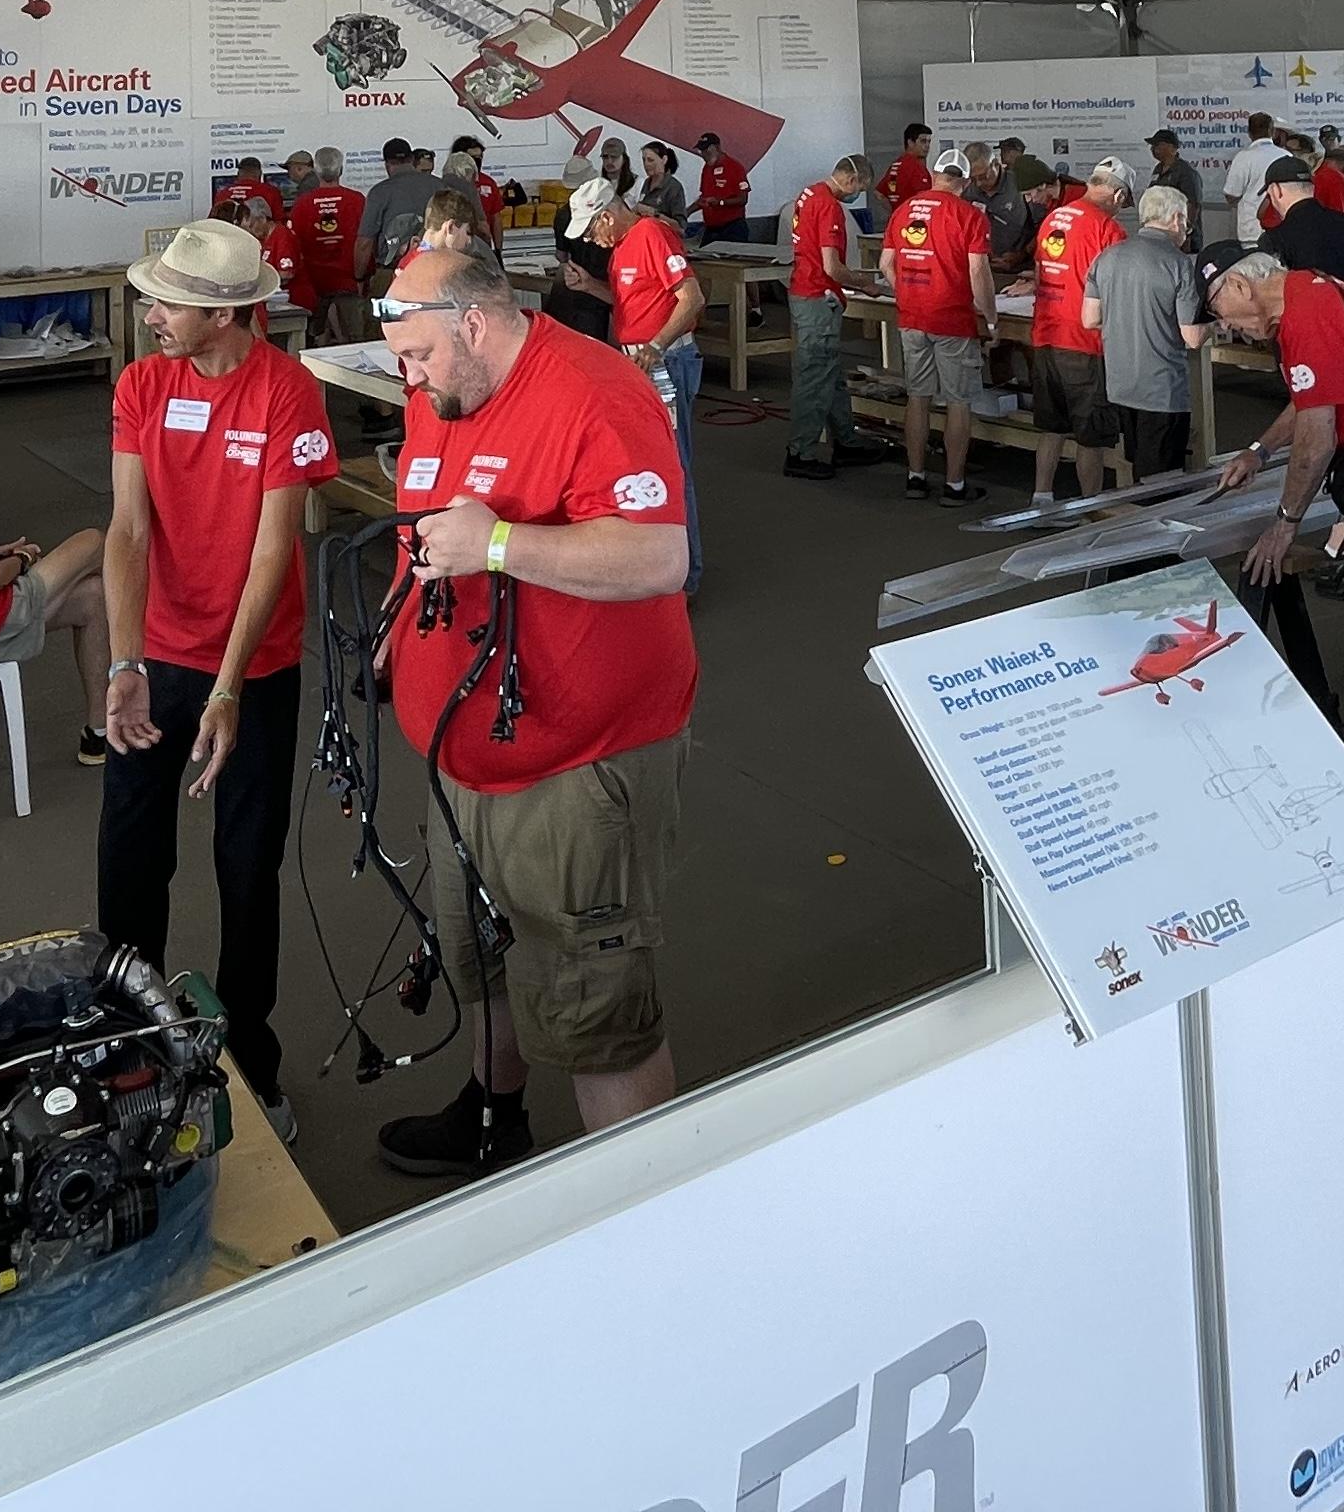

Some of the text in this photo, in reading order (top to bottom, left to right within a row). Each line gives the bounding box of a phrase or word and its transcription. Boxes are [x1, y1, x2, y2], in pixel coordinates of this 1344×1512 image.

[45, 68, 151, 93] Aircraft
[20, 94, 182, 116] in Seven Days
[344, 92, 405, 107] ROTAX
[938, 102, 962, 112] EAA
[996, 100, 1029, 110] Home
[1032, 99, 1048, 110] for
[1051, 98, 1135, 109] Homebuilders
[1166, 96, 1229, 106] More than
[1295, 93, 1322, 105] Help
[1167, 109, 1250, 121] 40,000 people
[1199, 123, 1225, 134] built
[1202, 157, 1219, 167] it's
[50, 172, 184, 198] WONDER
[927, 642, 1056, 693] Sonex Waiex-B
[940, 656, 1099, 714] Performance Data
[1152, 899, 1245, 956] WONDER
[1108, 970, 1143, 996] sonex
